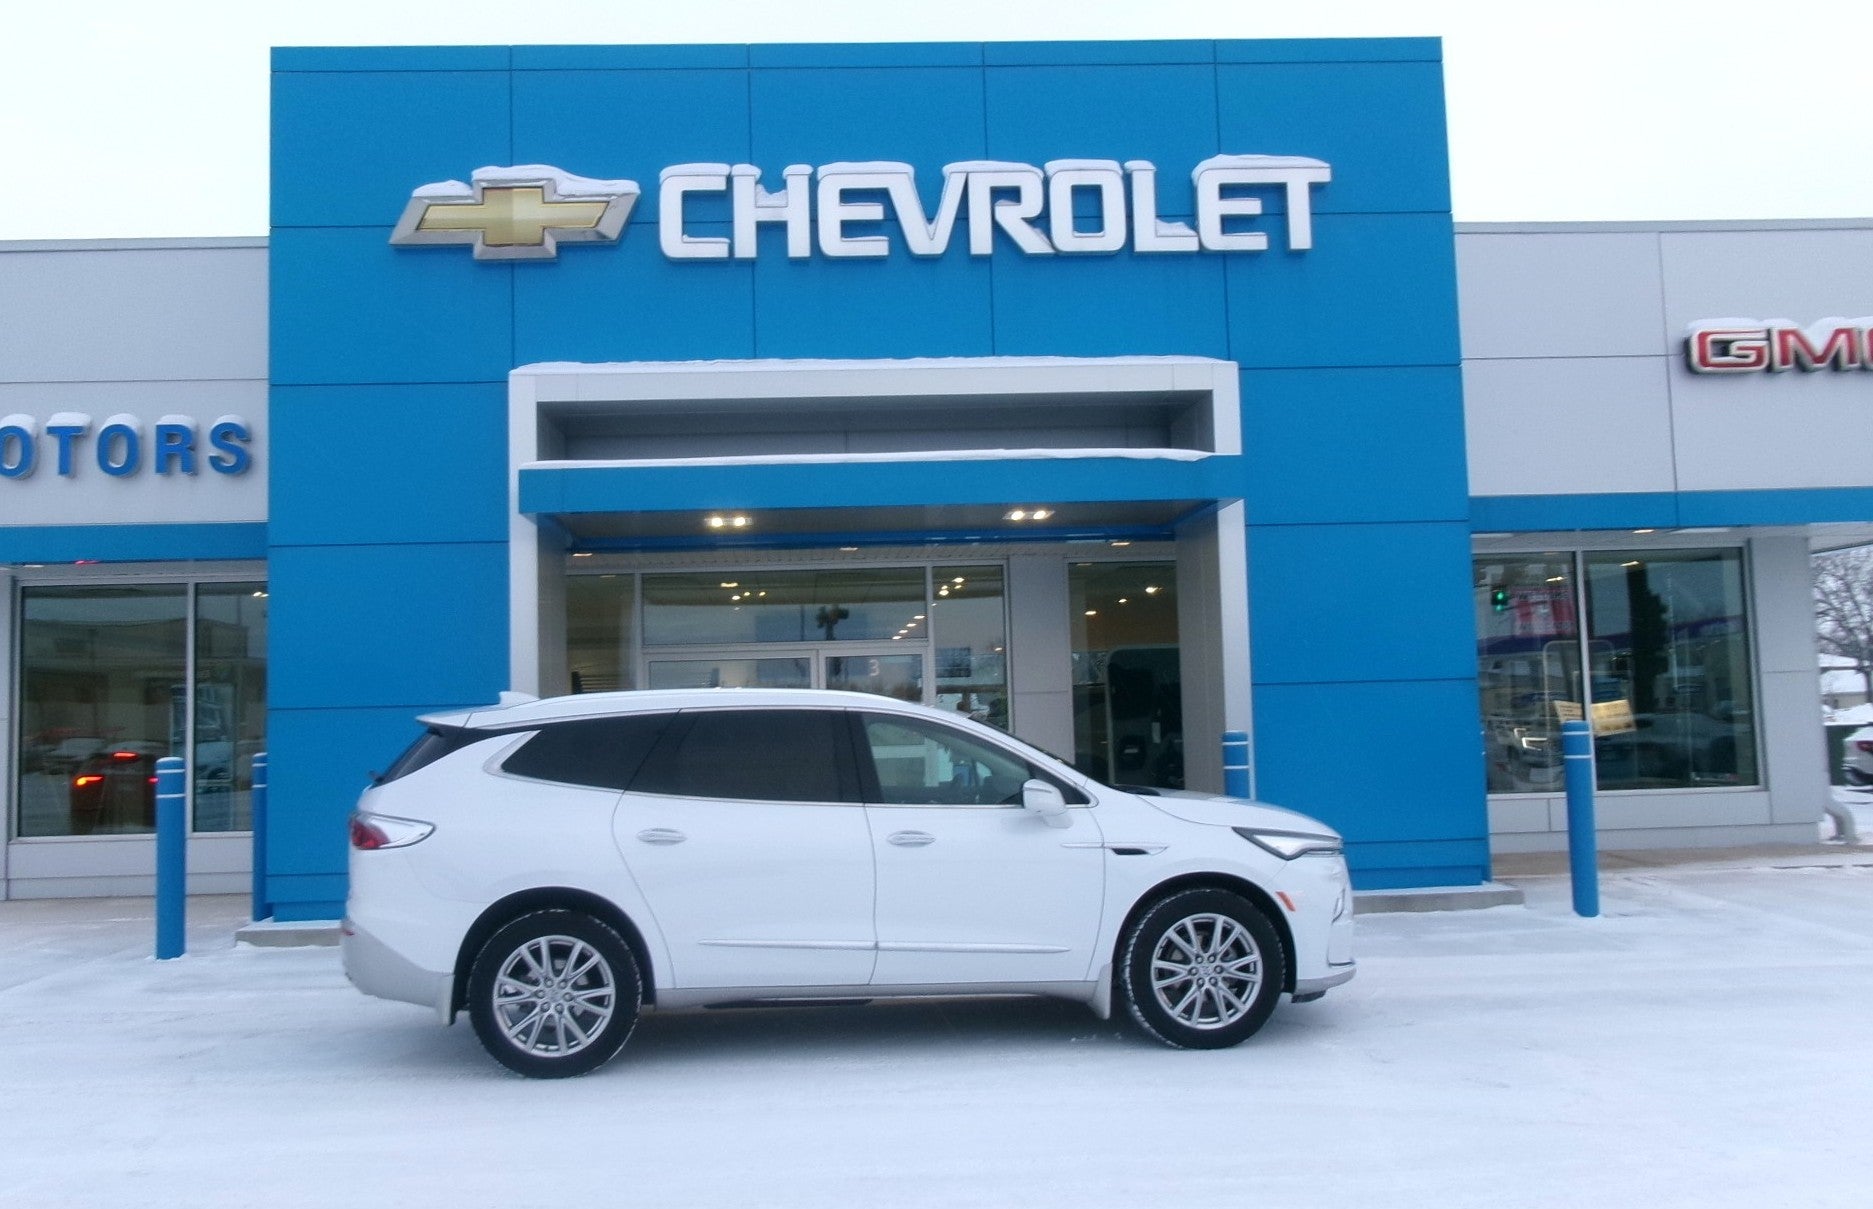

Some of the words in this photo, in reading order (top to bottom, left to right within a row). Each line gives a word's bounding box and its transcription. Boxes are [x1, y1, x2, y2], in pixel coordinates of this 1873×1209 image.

[660, 167, 1332, 259] CHEVROLET
[1689, 328, 1873, 374] GM
[0, 421, 251, 477] OTORS
[869, 659, 880, 677] 3
